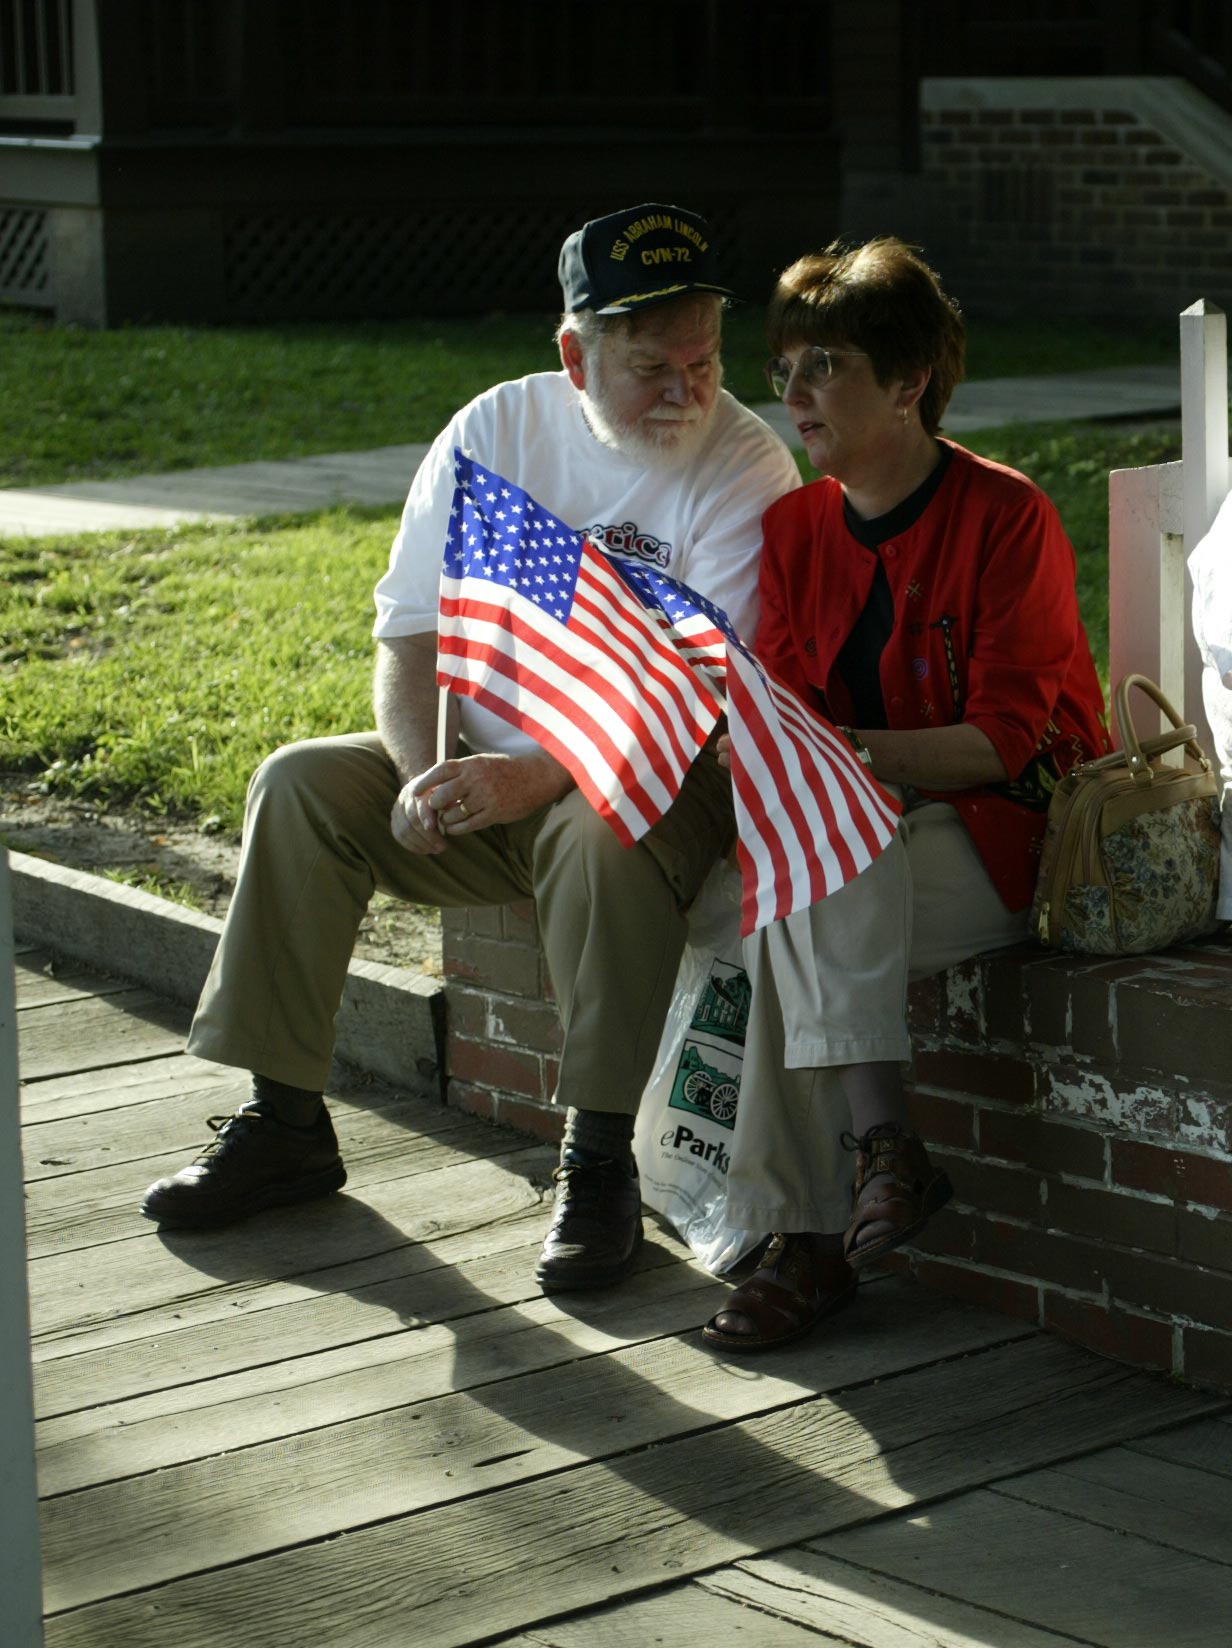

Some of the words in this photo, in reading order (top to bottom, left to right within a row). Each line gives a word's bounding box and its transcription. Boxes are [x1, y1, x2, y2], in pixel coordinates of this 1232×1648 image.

[609, 239, 630, 261] USS
[623, 214, 673, 244] ABRAHAM
[674, 218, 709, 253] LINCOLN
[641, 247, 693, 265] CVN-72
[660, 1124, 731, 1175] eParks
